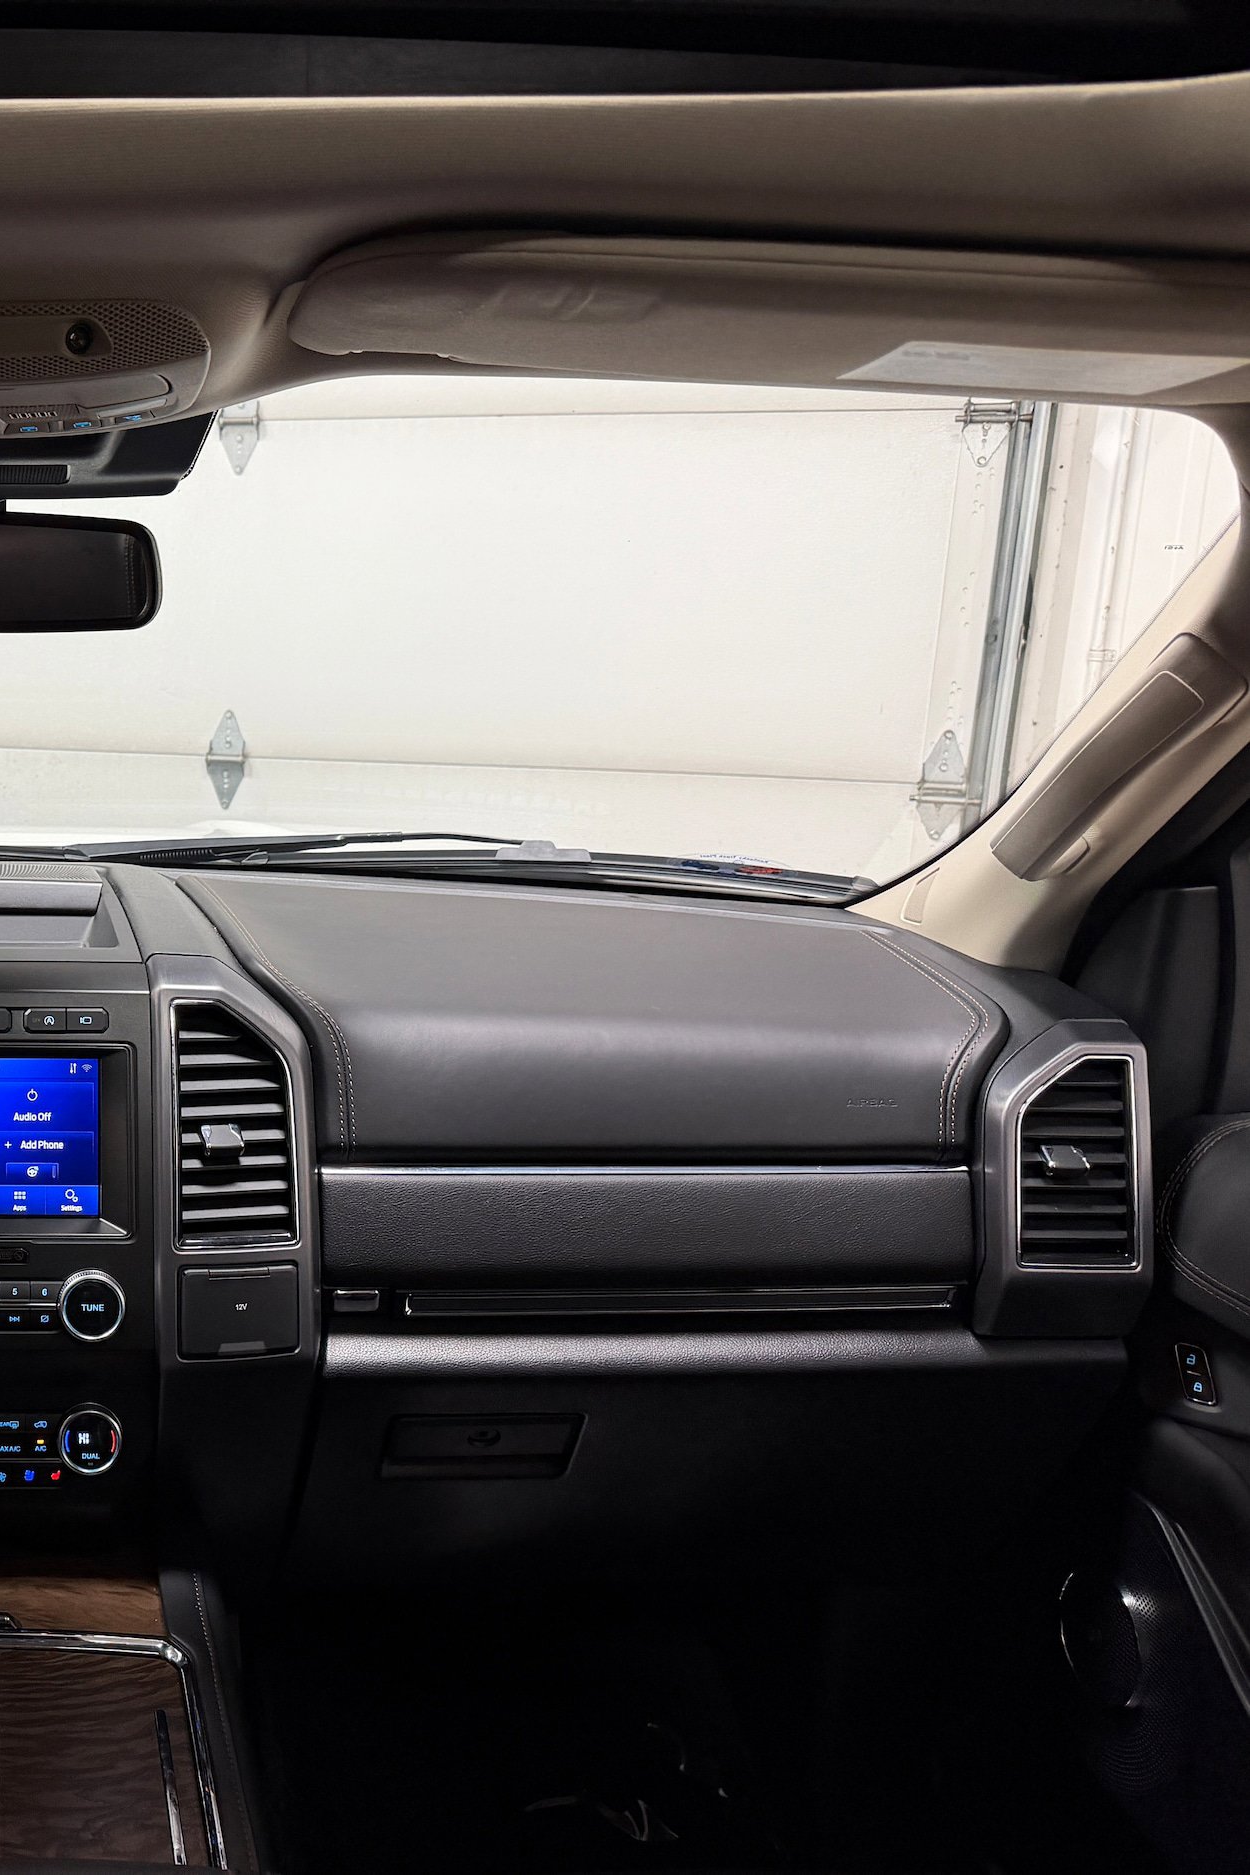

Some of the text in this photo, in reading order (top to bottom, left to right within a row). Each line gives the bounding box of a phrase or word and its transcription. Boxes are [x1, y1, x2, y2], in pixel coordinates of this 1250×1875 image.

[13, 1112, 52, 1121] Audio Off
[20, 1140, 64, 1150] Add Phone
[12, 1204, 27, 1212] Apps
[61, 1204, 83, 1212] Settings
[12, 1287, 18, 1296] 5
[41, 1287, 48, 1296] 6
[81, 1303, 104, 1312] TUNE
[235, 1303, 248, 1311] 12V
